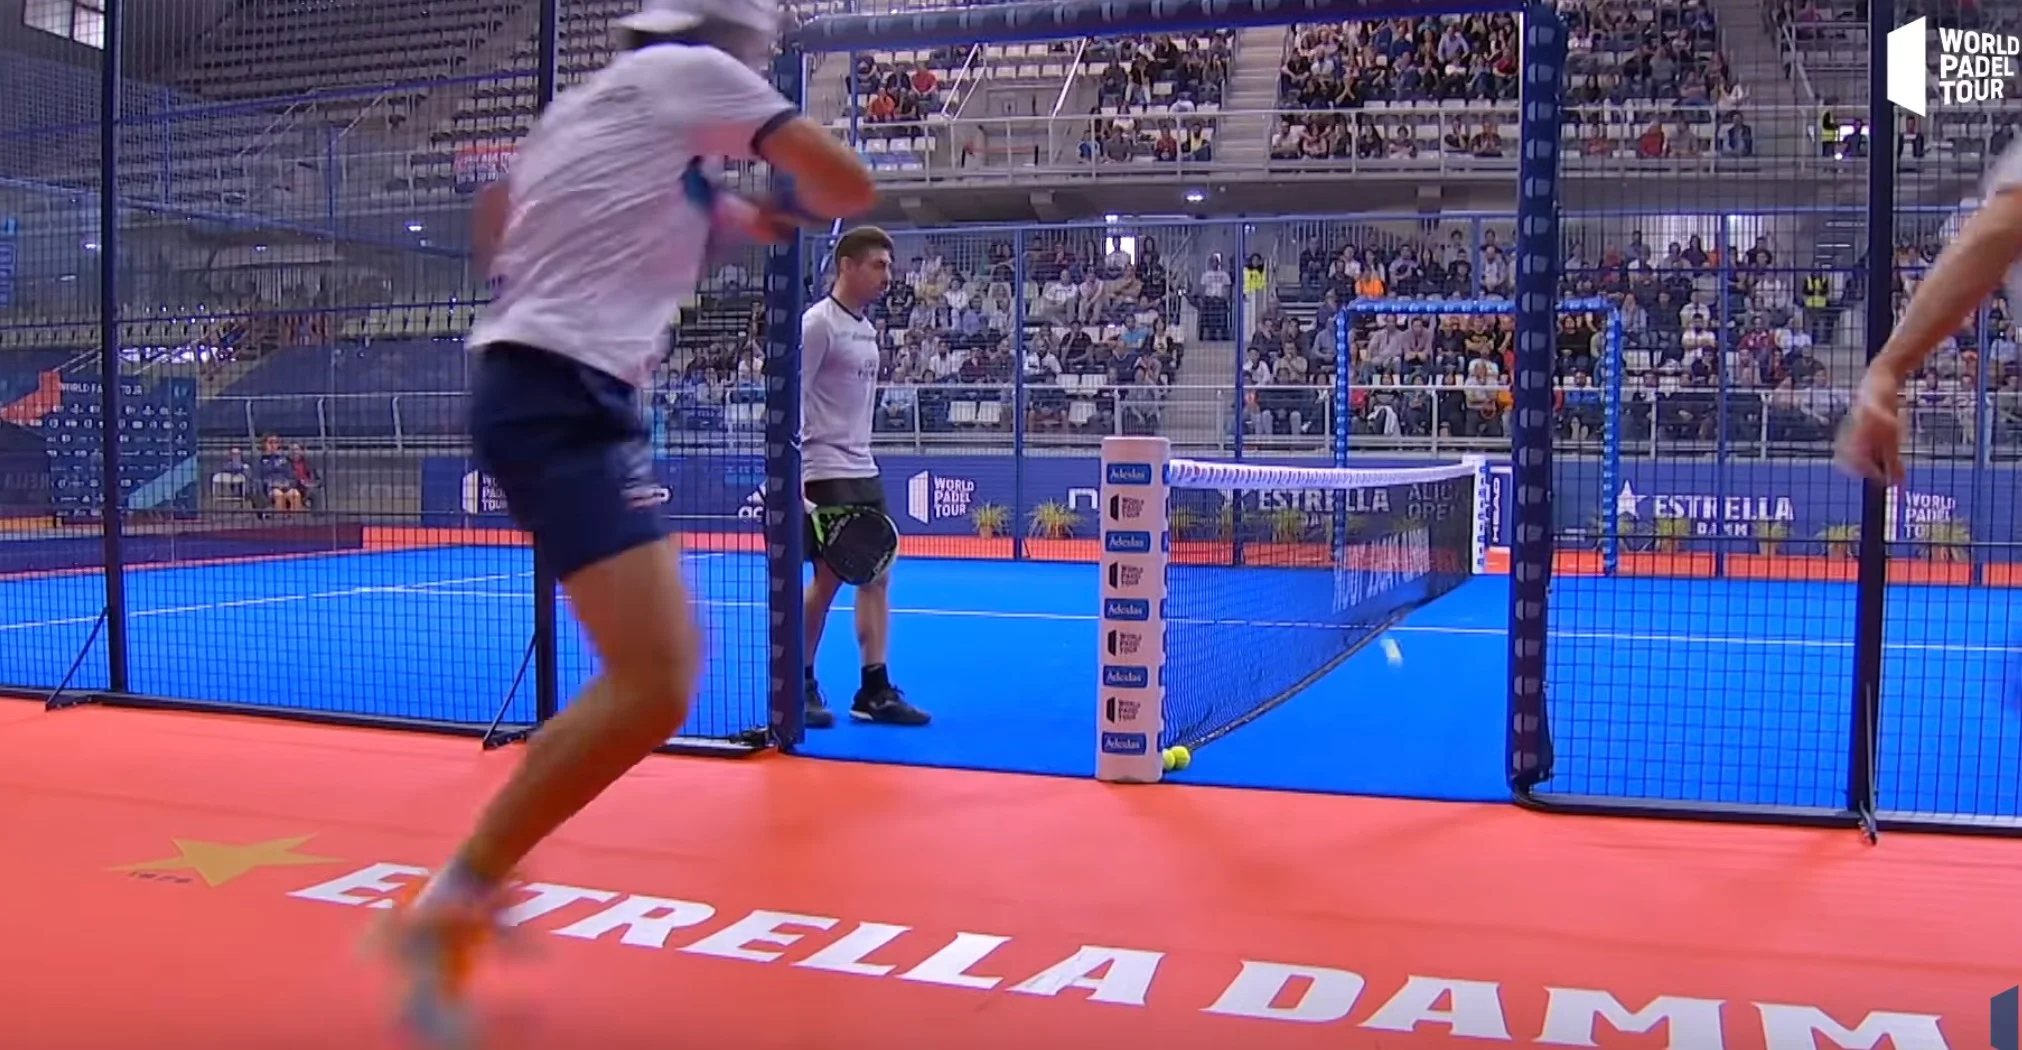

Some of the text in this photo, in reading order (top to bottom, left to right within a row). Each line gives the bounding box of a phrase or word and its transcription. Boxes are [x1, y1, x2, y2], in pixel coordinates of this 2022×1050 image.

[934, 475, 974, 492] WORLD
[934, 489, 971, 504] PADEL
[1905, 491, 1956, 510] WORLD
[934, 503, 966, 518] TOUR
[1492, 477, 1501, 543] HEAD
[1653, 495, 1794, 521] ESTRELLA
[286, 861, 1950, 1050] ETRELLA DAMM
